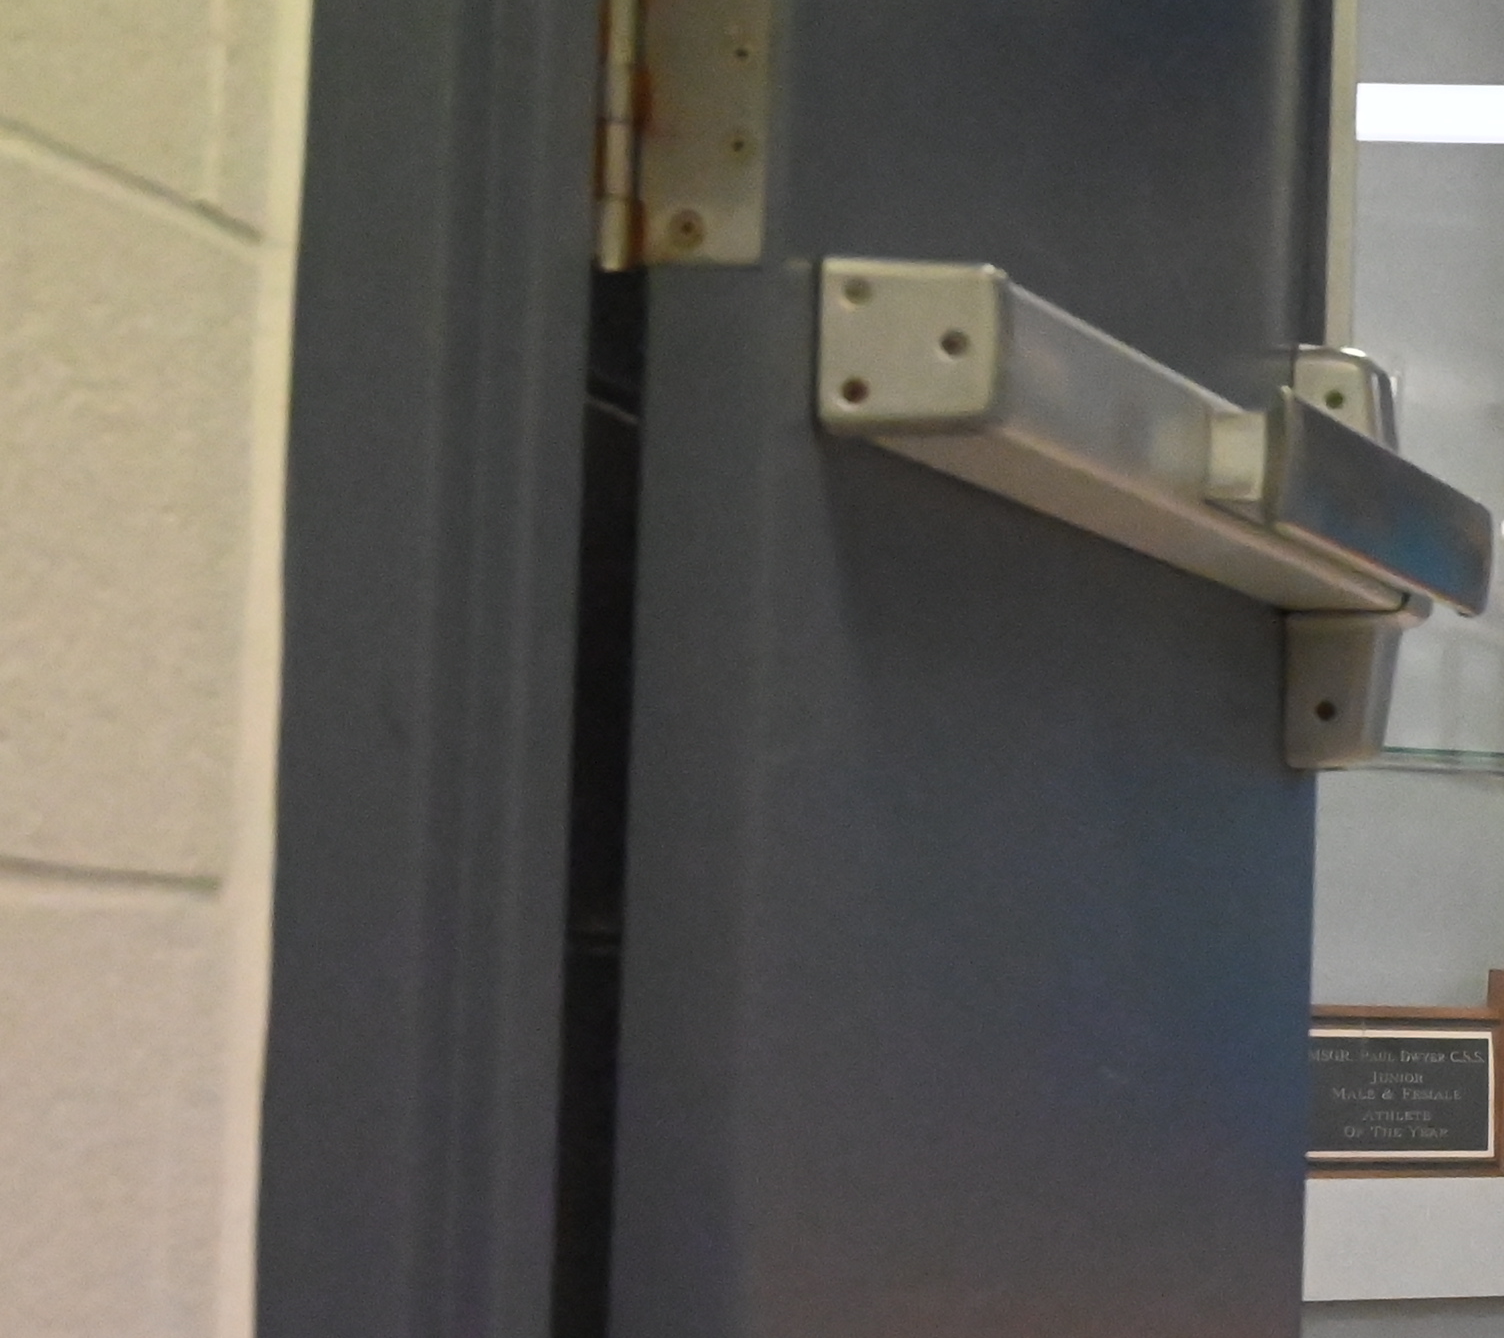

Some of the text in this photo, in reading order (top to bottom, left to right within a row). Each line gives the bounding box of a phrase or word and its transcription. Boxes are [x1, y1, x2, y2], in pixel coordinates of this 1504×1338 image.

[1361, 1051, 1395, 1062] PAUL
[1400, 1050, 1446, 1062] DWYER
[1370, 1071, 1424, 1084] JUNIOR
[1332, 1087, 1462, 1100] MALE & FEMALE
[1362, 1110, 1432, 1121] ATHLETE
[1408, 1126, 1449, 1138] YEAR
